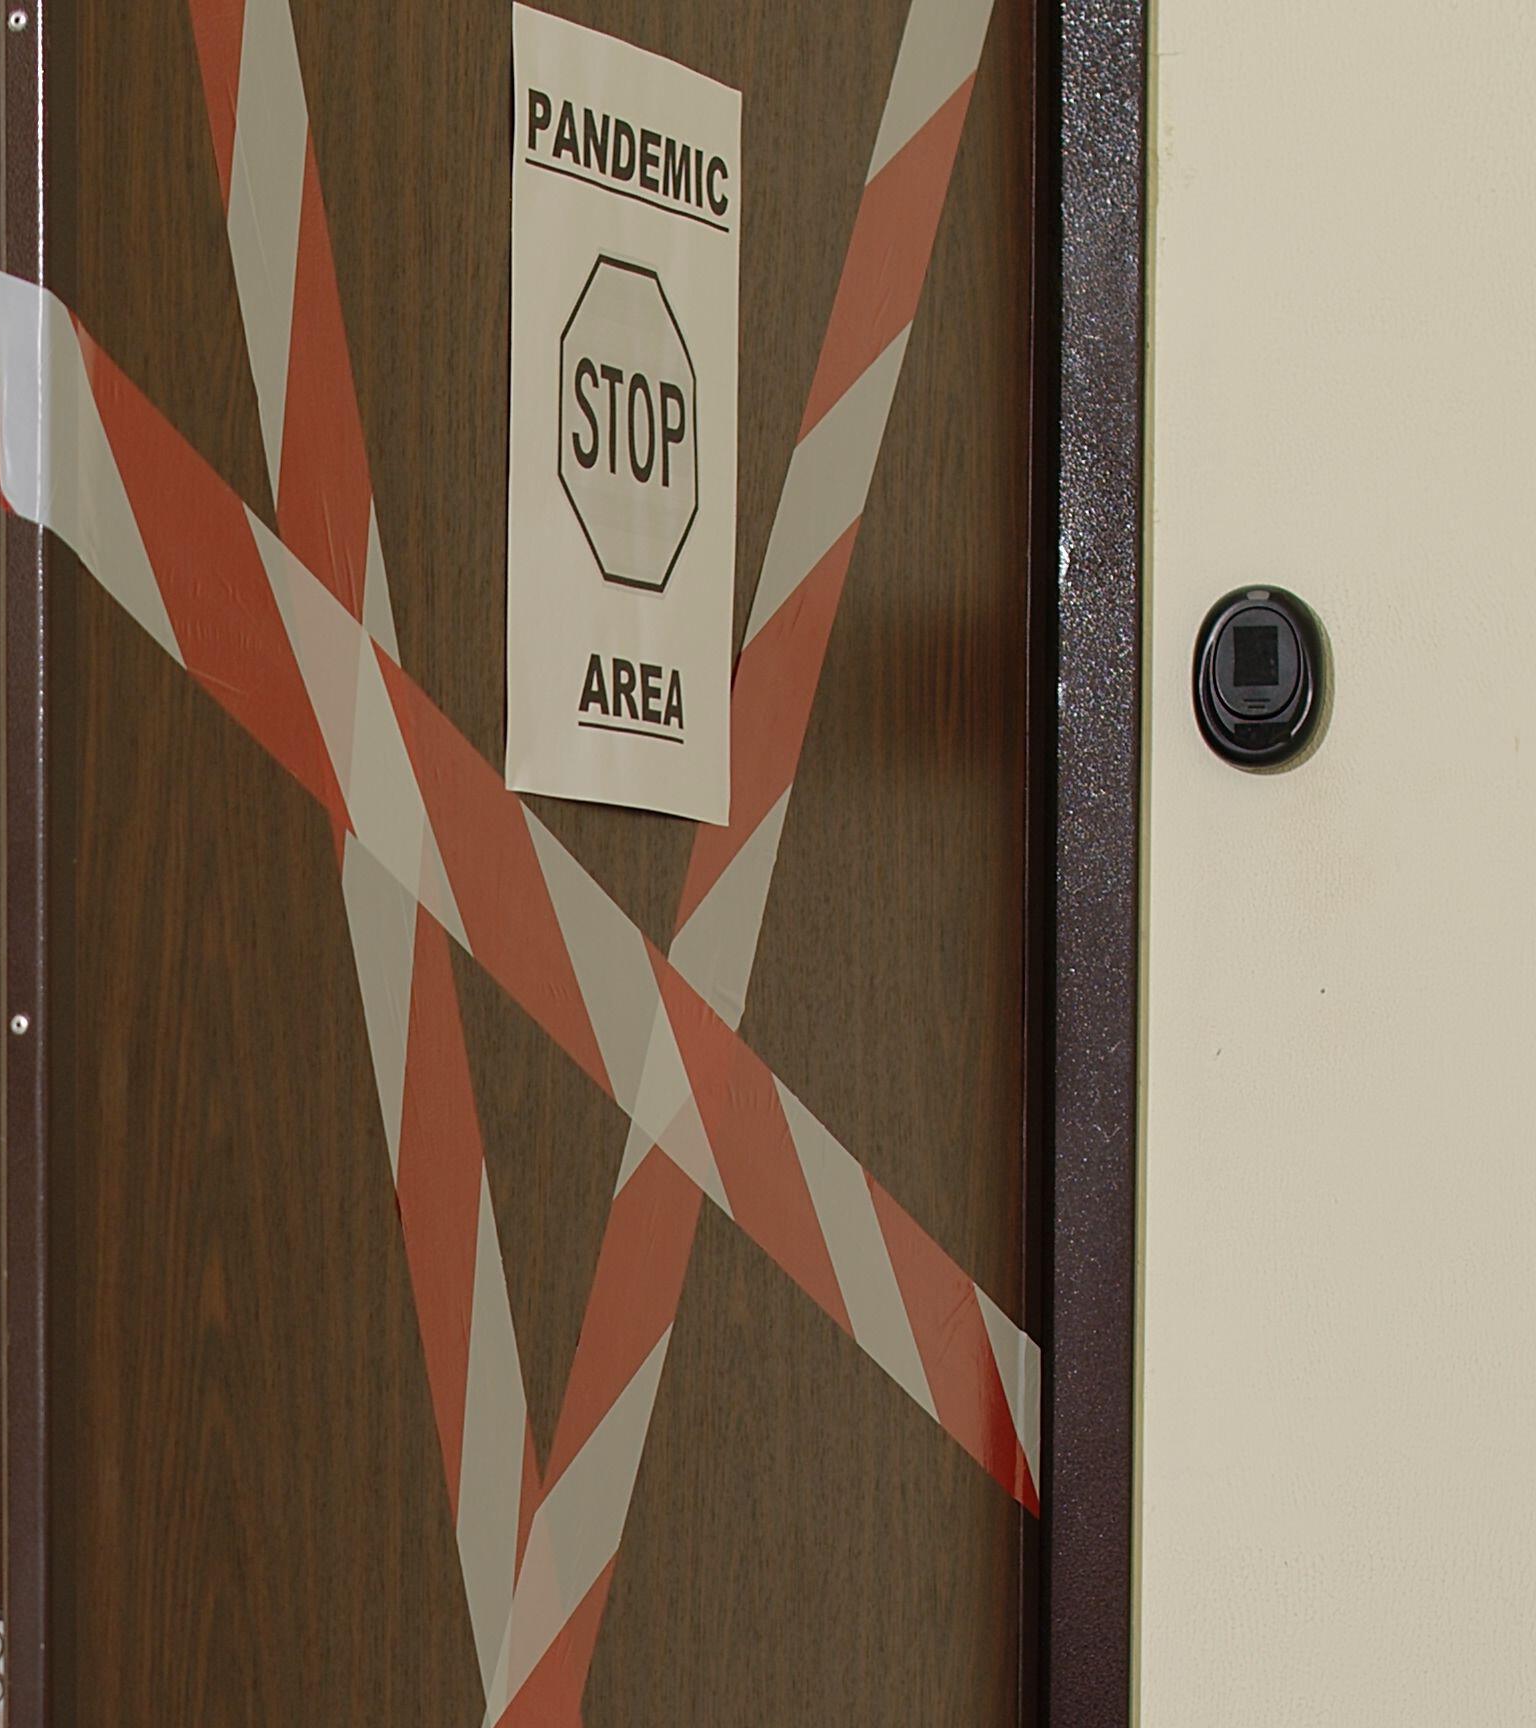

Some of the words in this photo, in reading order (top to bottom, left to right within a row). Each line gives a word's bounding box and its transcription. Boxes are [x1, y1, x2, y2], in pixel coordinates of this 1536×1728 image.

[527, 88, 730, 217] PANDEMIC
[572, 357, 687, 489] STOP
[578, 653, 685, 730] AREA
